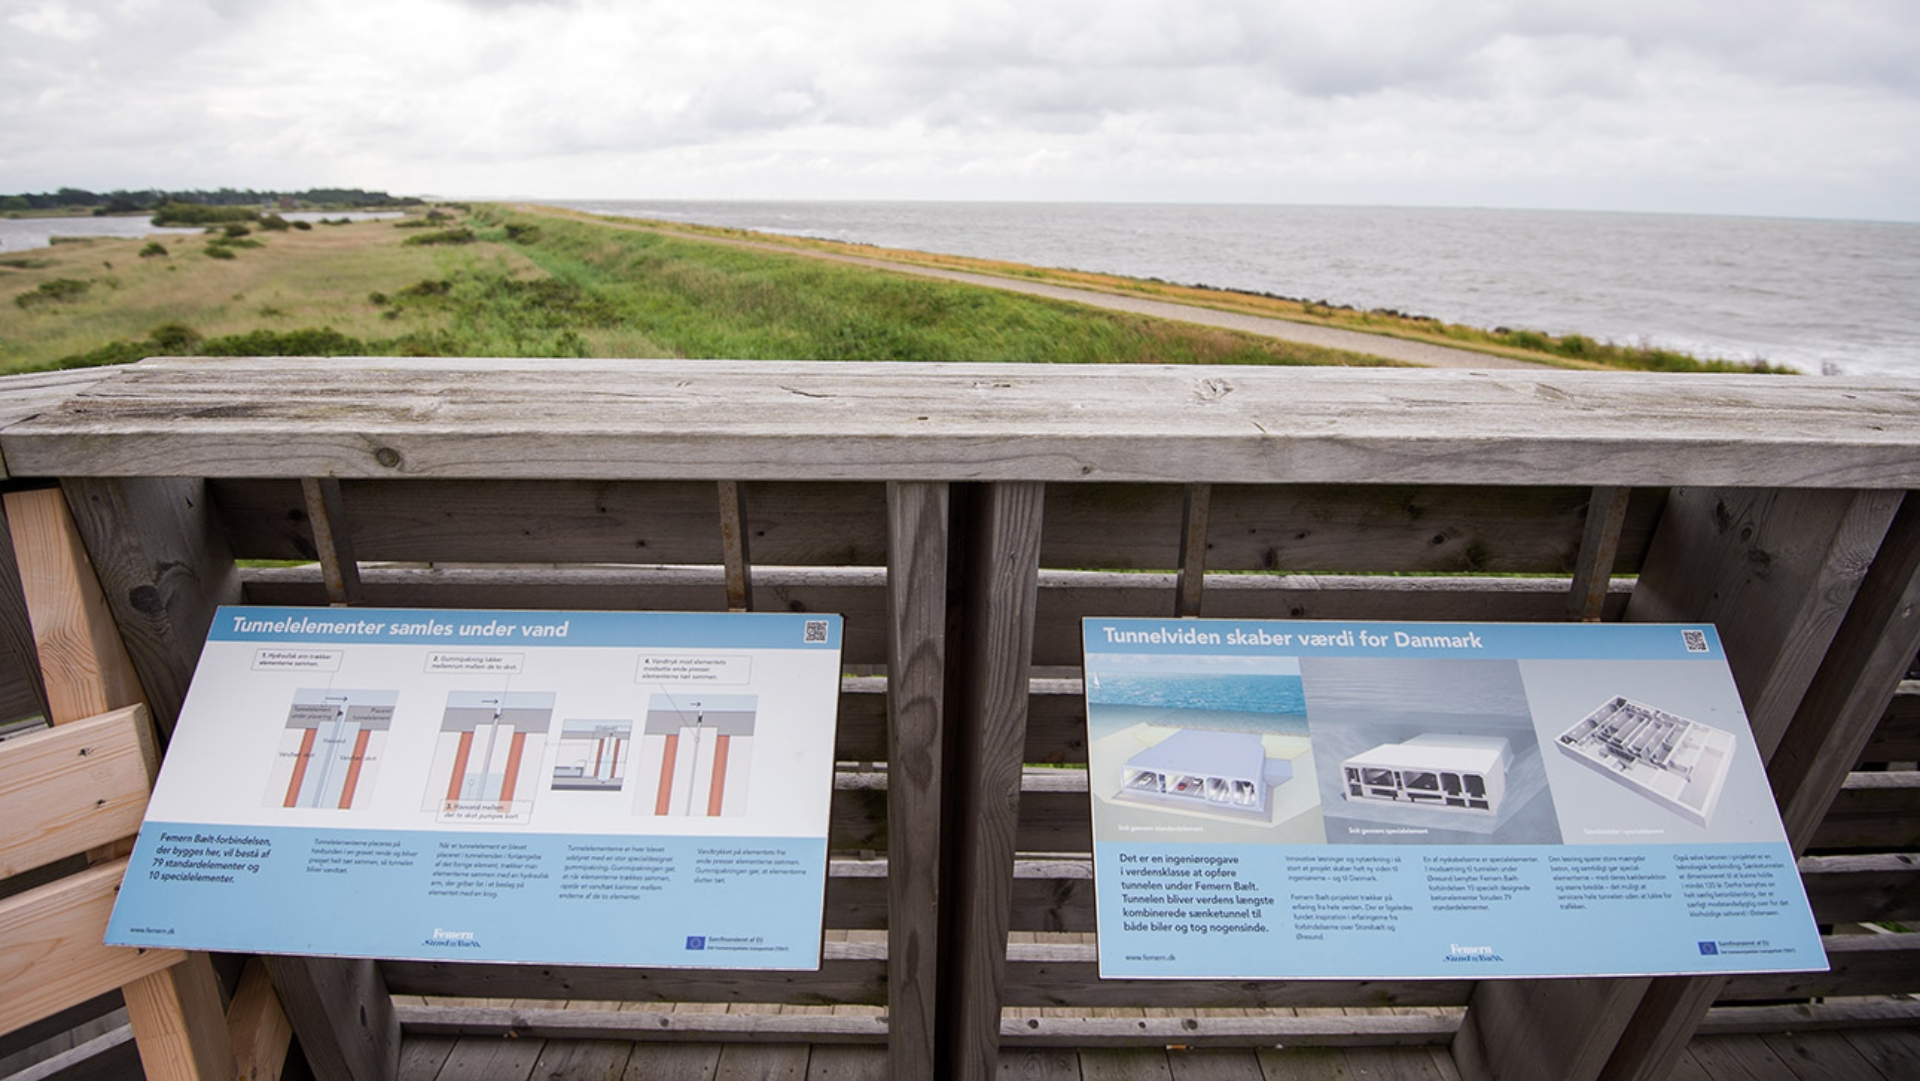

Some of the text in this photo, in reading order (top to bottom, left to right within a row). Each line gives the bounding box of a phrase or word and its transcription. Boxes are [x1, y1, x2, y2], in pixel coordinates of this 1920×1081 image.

[233, 618, 570, 637] Tunnelelementer samles under vand
[1103, 628, 1483, 648] Tunnelviden skaber værdi for Danmark
[160, 832, 271, 847] Femern Bælt-forbindelsen,
[156, 846, 270, 858] der bygges her, vil bestå af
[152, 858, 259, 872] 79 standardelementer og
[1119, 854, 1137, 862] Det
[1164, 854, 1239, 865] ingeniøropgave
[148, 870, 234, 884] 10 specialelementer.
[1120, 867, 1237, 878] i verdensklasse at opføre
[1121, 880, 1259, 890] tunnelen under Femern Bælt.
[1122, 894, 1274, 906] Tunnelen bliver verdens længste
[1122, 908, 1262, 918] kombinerede sænketunnel til
[1123, 922, 1270, 933] både biler og tog nogensinde.
[433, 929, 474, 939] Femern
[1450, 944, 1492, 954] Femern
